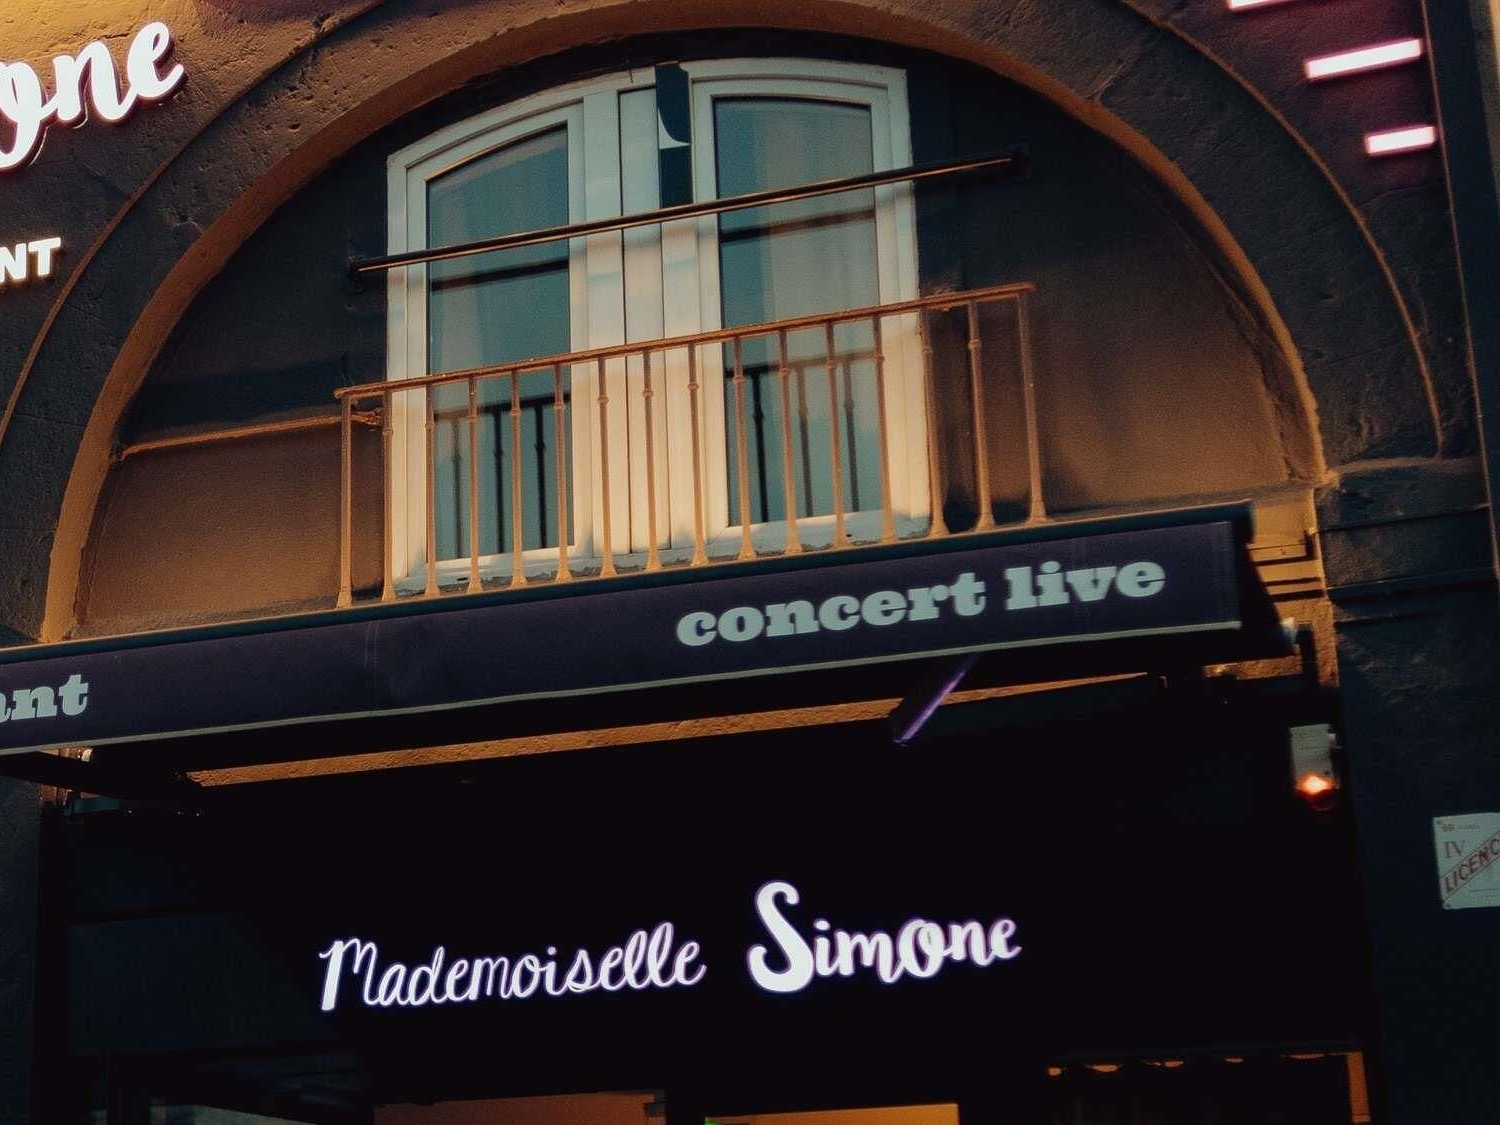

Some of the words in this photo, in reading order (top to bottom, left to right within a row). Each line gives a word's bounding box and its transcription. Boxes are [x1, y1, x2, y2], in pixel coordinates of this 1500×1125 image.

[676, 572, 986, 647] concert
[1004, 560, 1167, 611] live
[319, 921, 708, 1012] Mademoiselle
[747, 881, 1022, 993] Simone
